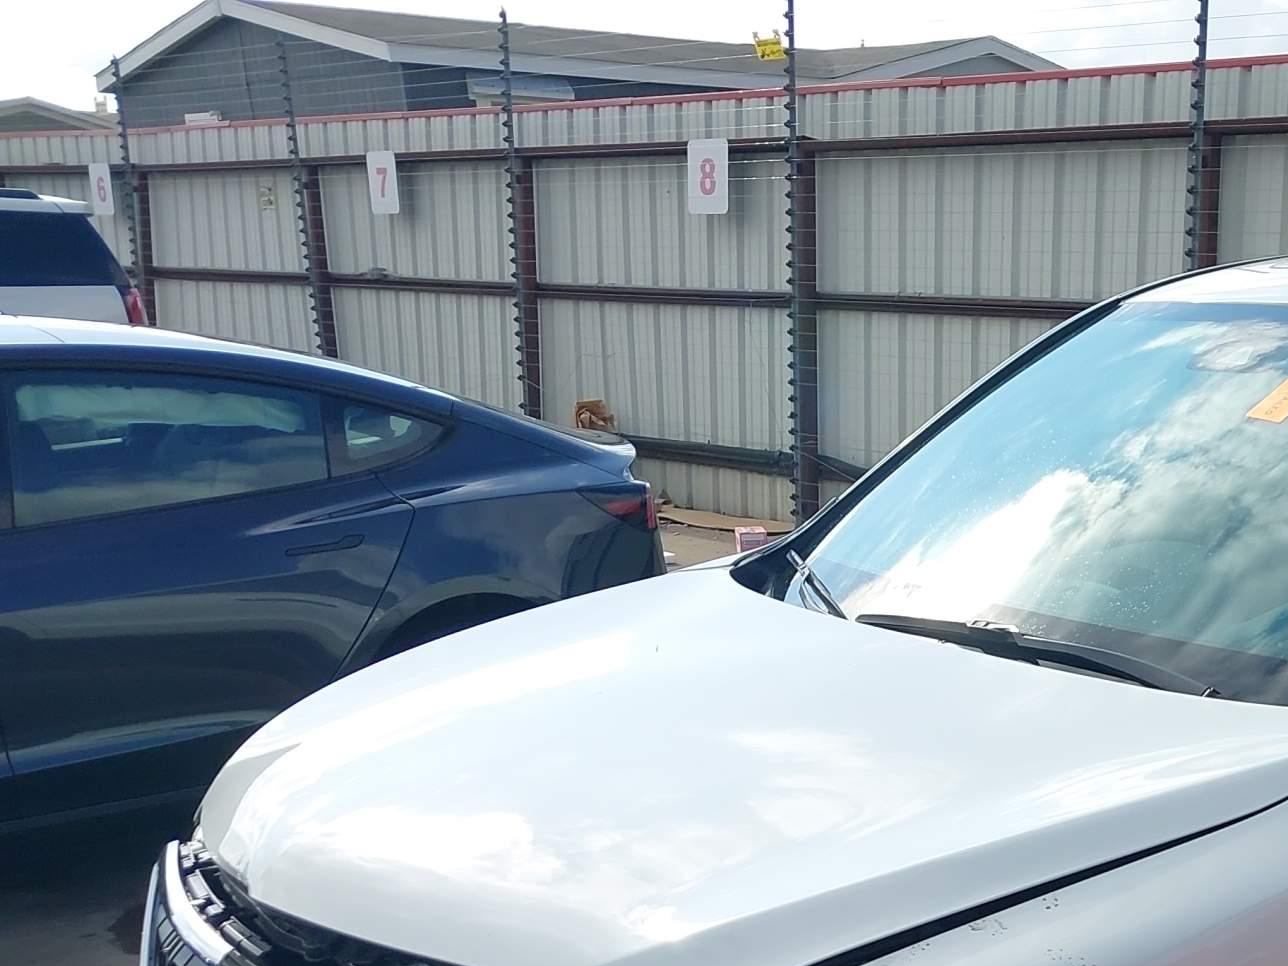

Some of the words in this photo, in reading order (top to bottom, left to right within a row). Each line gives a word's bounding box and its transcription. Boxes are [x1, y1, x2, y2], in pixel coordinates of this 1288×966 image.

[96, 176, 106, 203] 6
[375, 167, 387, 198] 7
[700, 157, 716, 196] 8
